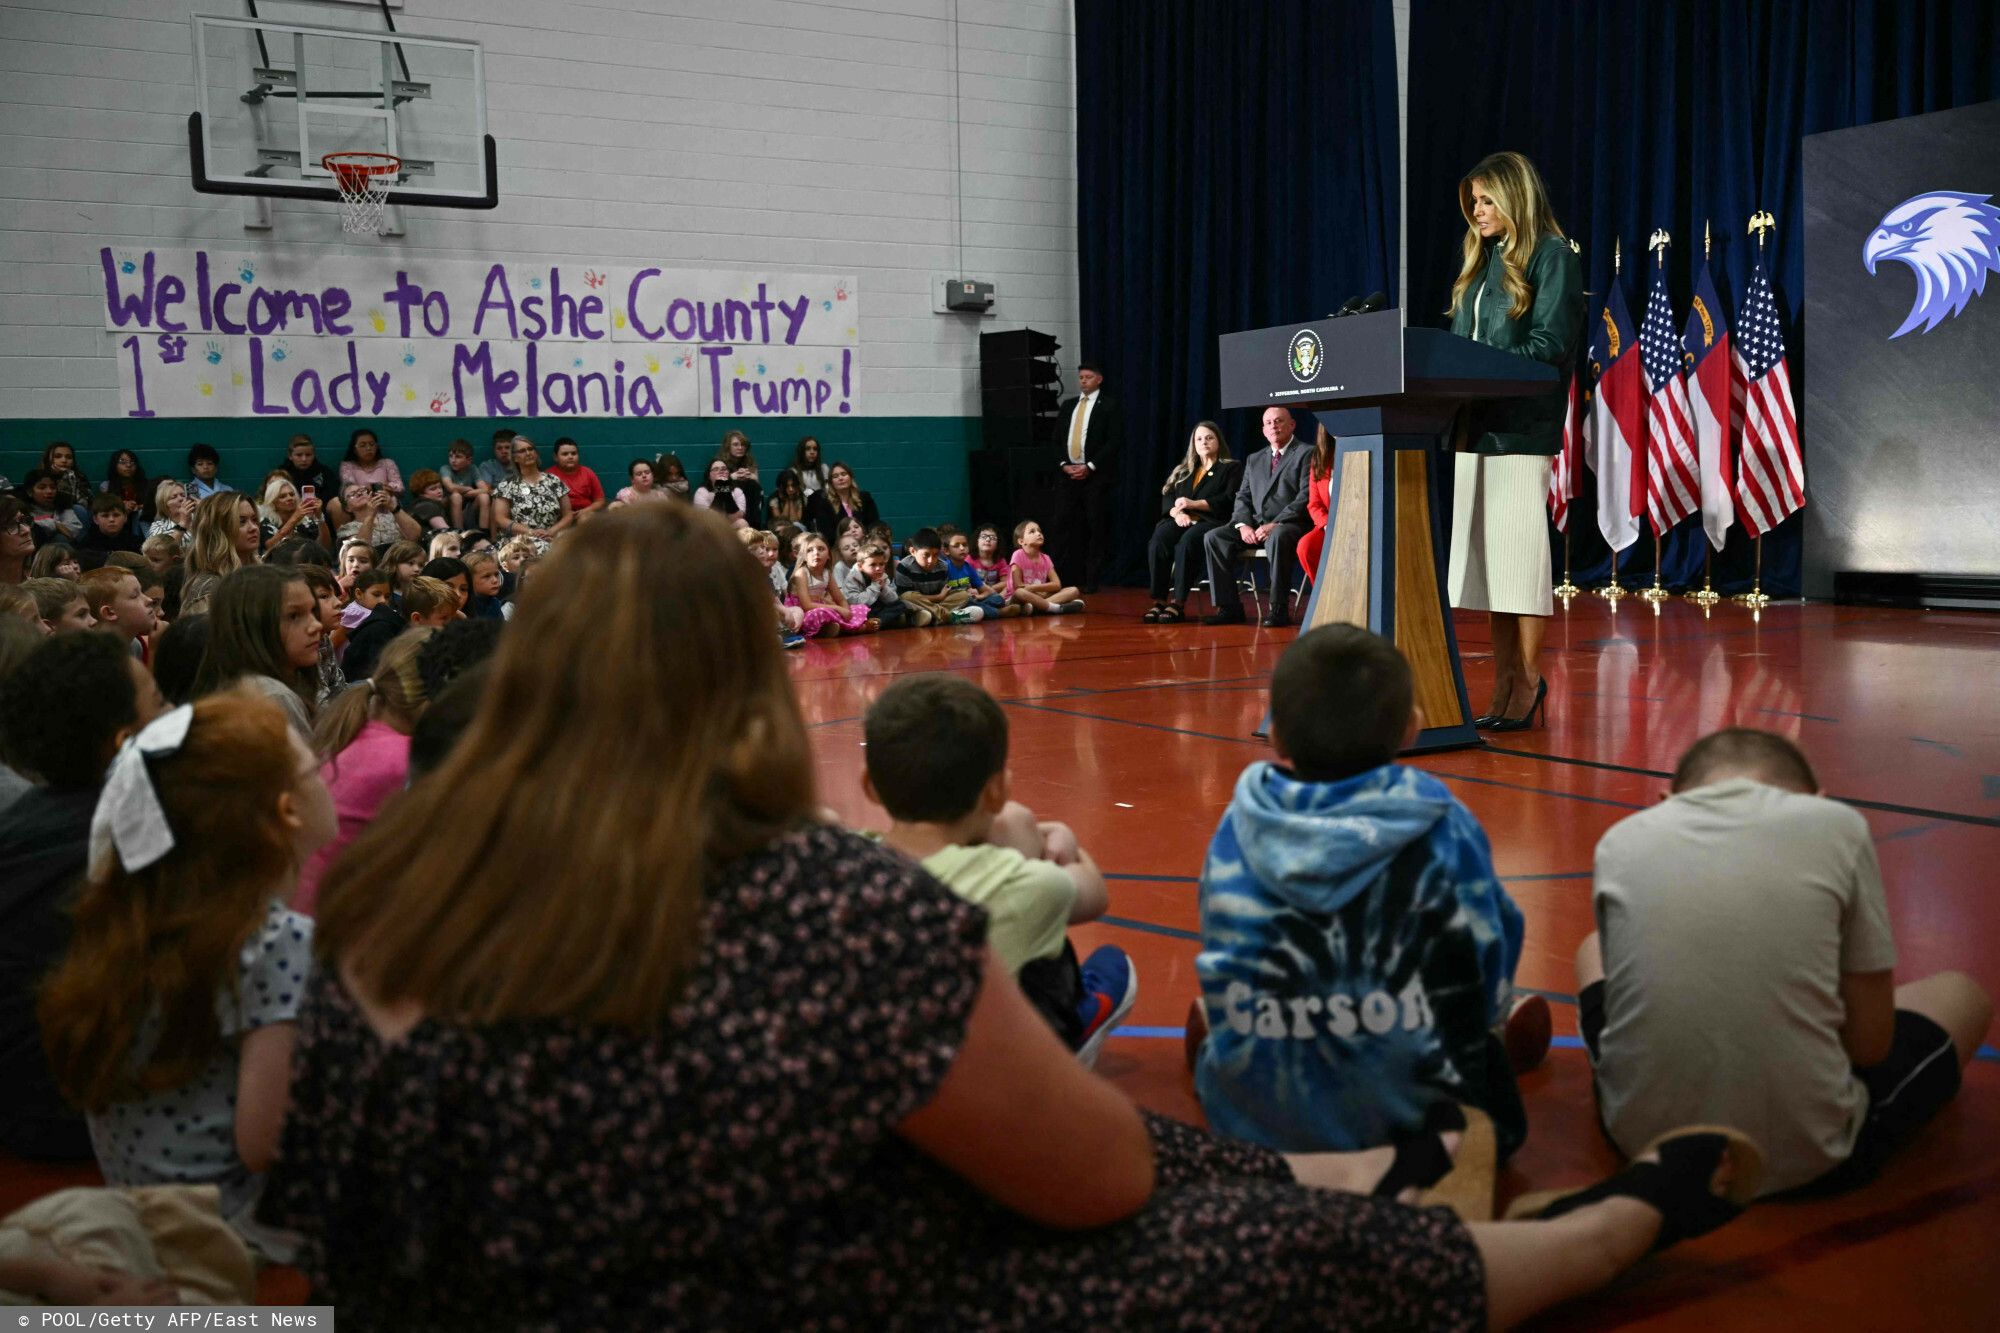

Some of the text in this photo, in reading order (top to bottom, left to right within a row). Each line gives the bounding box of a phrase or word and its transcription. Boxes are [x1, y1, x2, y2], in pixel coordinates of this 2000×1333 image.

[100, 247, 810, 345] Welcome to Ashe County
[249, 336, 391, 416] Lady
[452, 340, 664, 417] Melania
[700, 346, 851, 416] Trump!
[1226, 971, 1435, 1040] Carson
